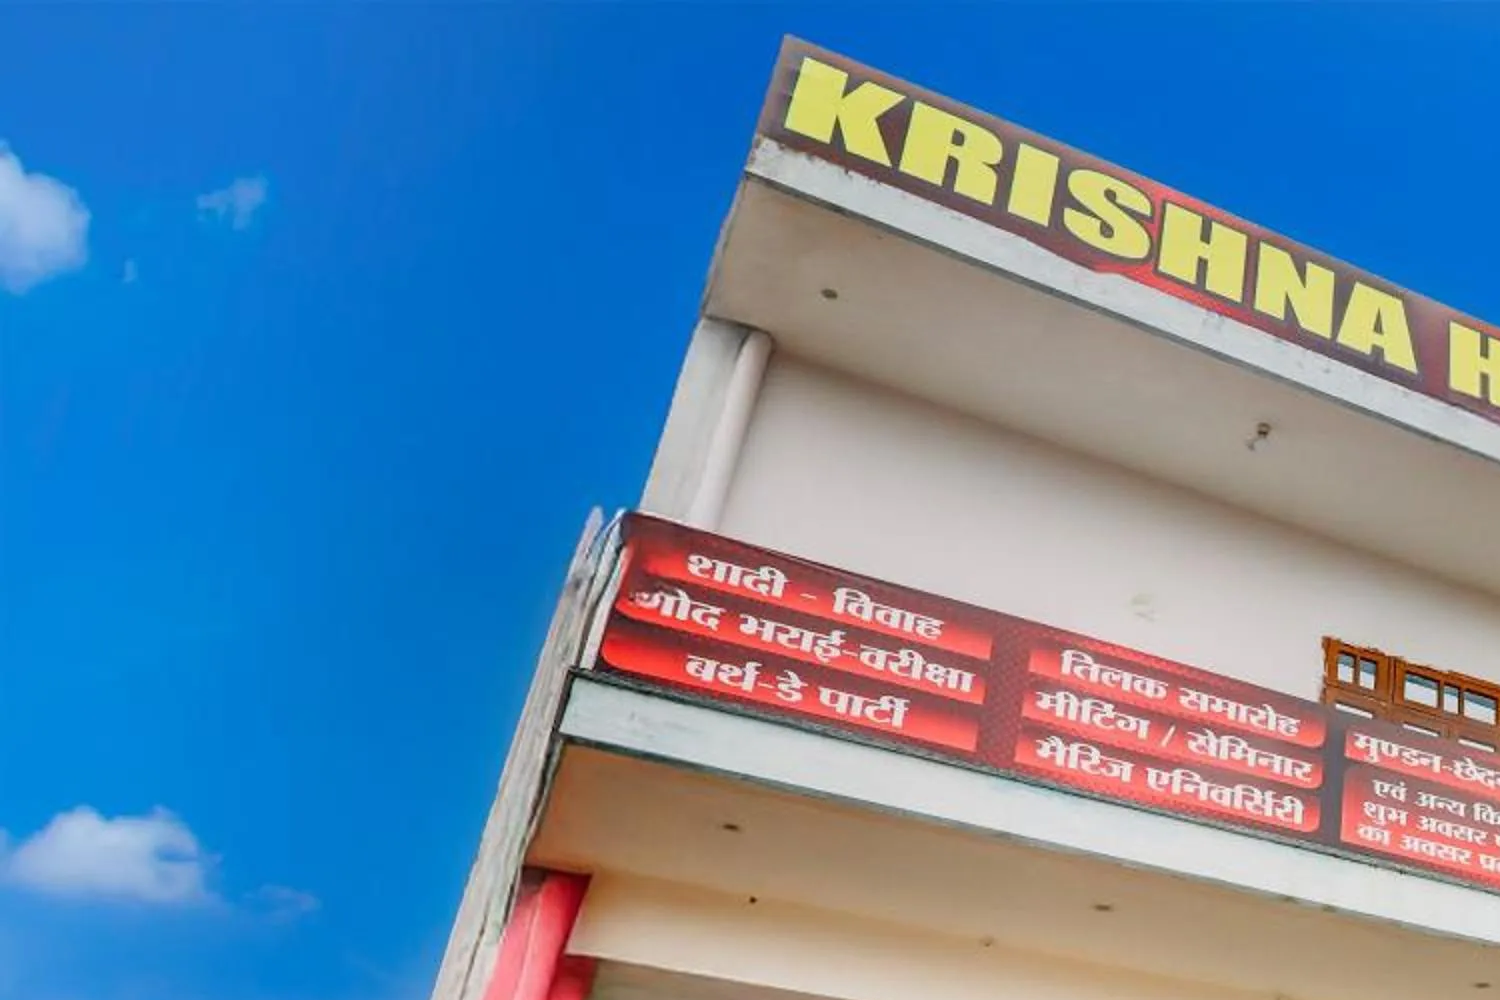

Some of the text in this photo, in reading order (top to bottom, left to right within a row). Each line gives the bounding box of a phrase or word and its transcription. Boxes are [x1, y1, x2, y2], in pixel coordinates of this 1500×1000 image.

[784, 56, 1418, 374] KRISHNA
[633, 587, 727, 632] गोद
[687, 553, 790, 599] शादी
[832, 587, 945, 642] विवाह
[818, 685, 909, 728] पार्टी
[1060, 649, 1301, 738] तिलक समारोह
[1035, 690, 1151, 740] मीटिंग
[1185, 727, 1312, 782] सेमिनार
[1035, 735, 1135, 783] मैरिज
[1372, 778, 1408, 802] एवं
[1415, 791, 1466, 817] अन्य
[1356, 824, 1391, 847] का
[1400, 835, 1473, 864] अवसर
[1362, 800, 1408, 827] शुभ
[1416, 814, 1488, 845] अवसर
